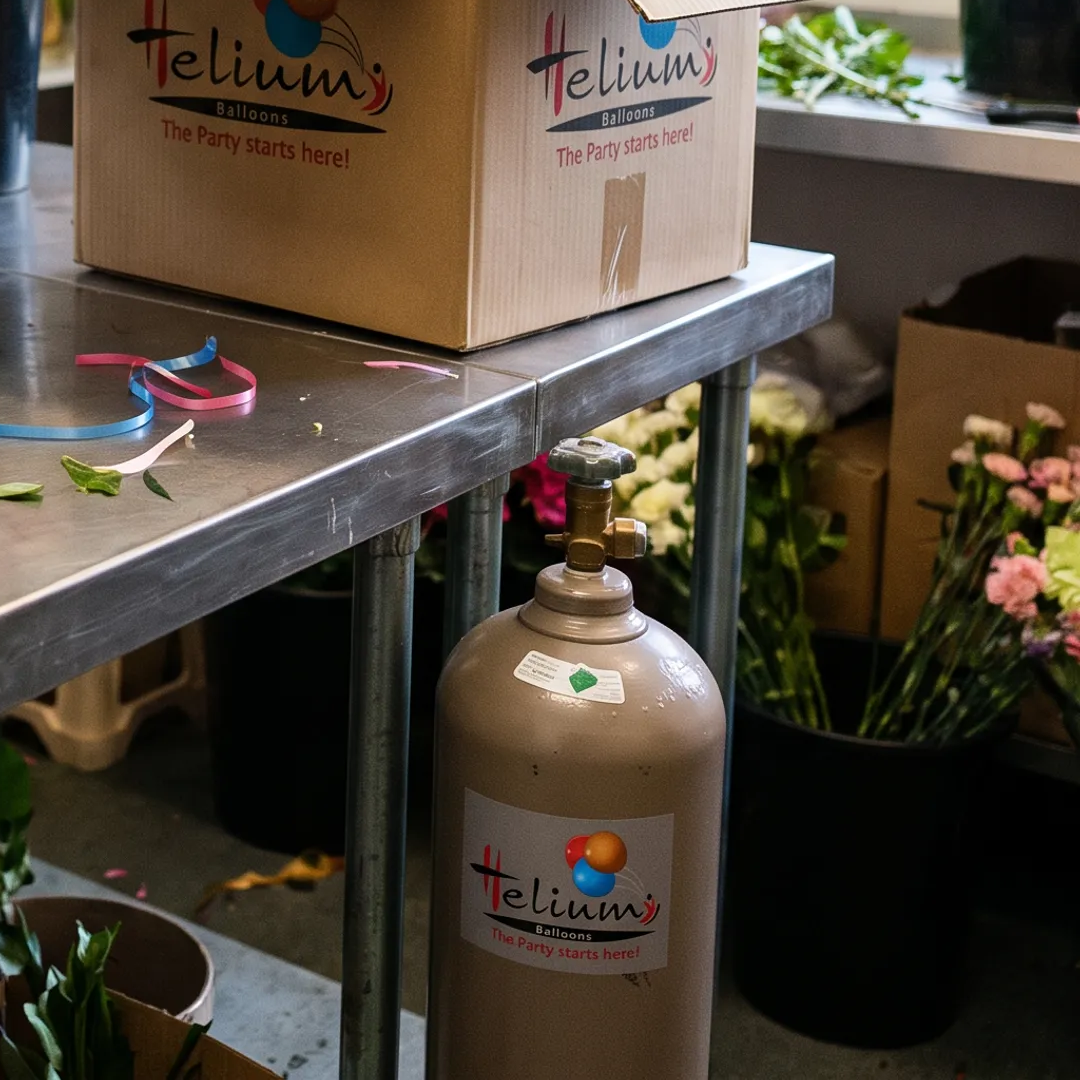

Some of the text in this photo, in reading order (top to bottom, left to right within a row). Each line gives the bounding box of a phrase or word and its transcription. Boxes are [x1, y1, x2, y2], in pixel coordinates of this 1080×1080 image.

[216, 102, 289, 125] Balloons
[601, 105, 655, 127] Balloons
[161, 119, 350, 169] The Party starts here!
[556, 122, 694, 168] The Party starts here!
[491, 927, 641, 961] The Party starts here!
[535, 925, 593, 941] Balloons
